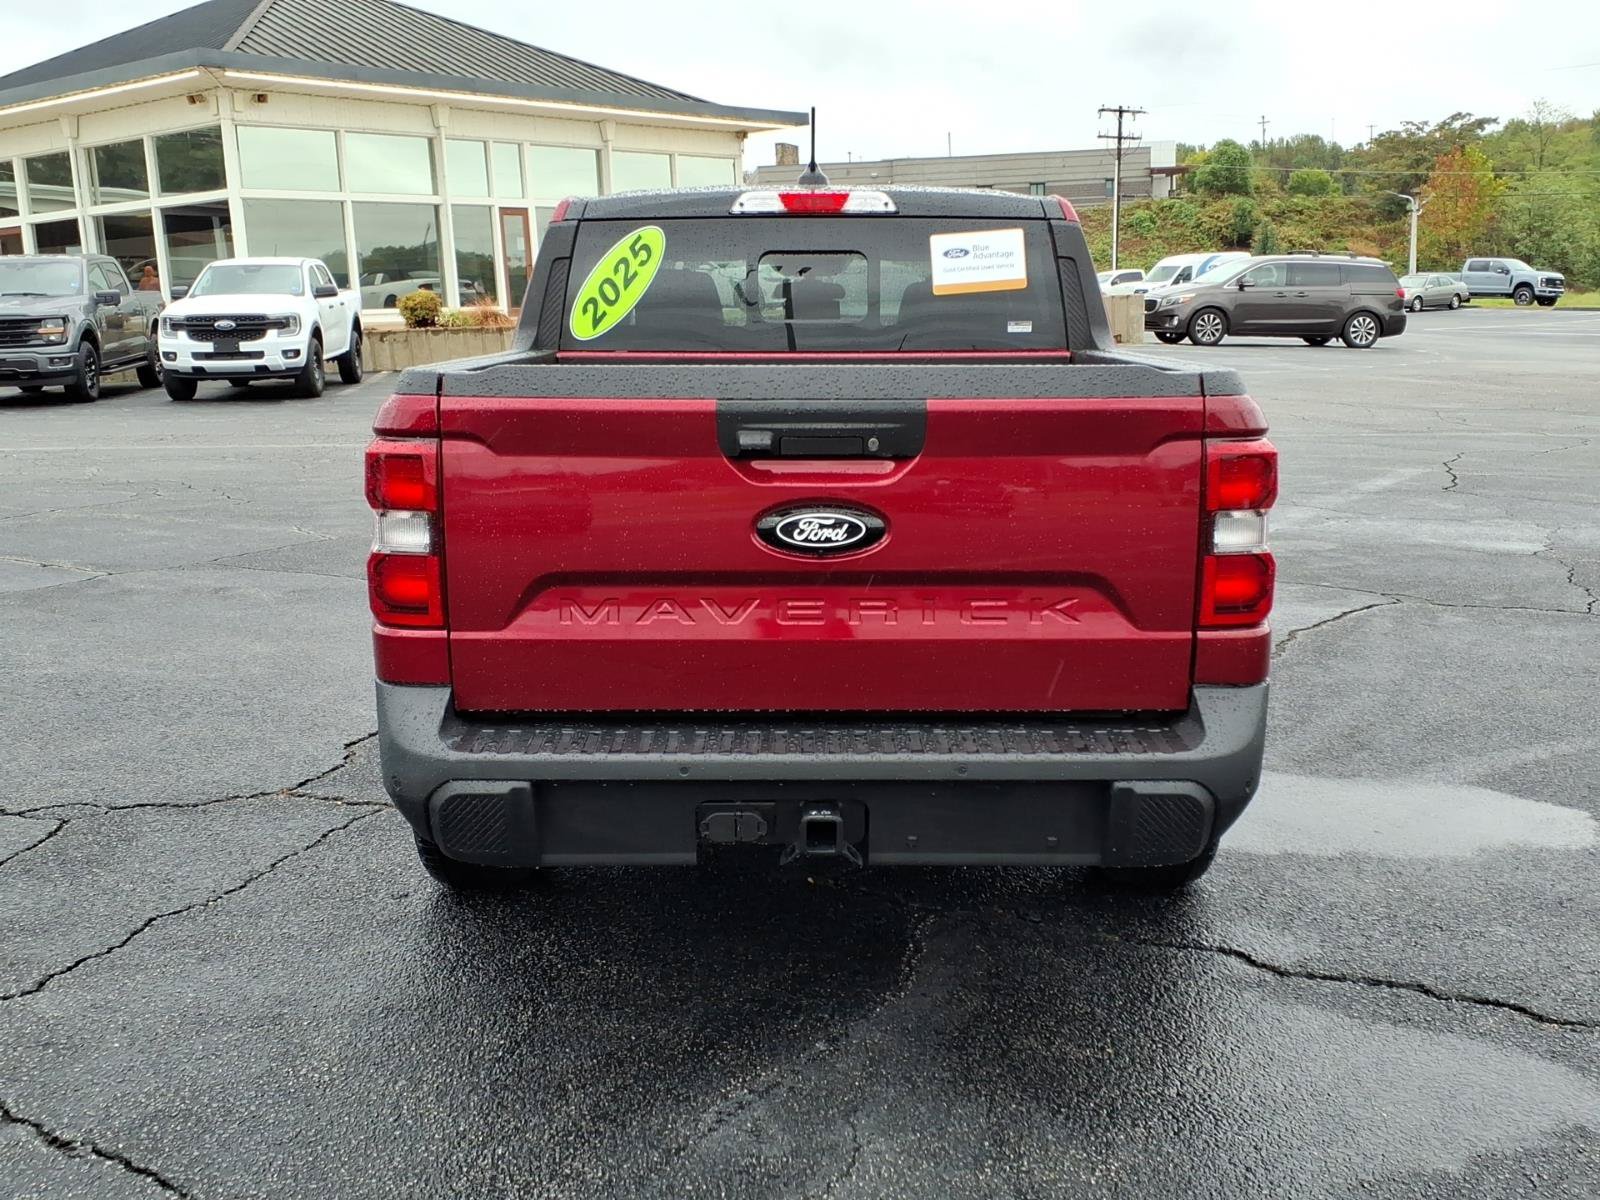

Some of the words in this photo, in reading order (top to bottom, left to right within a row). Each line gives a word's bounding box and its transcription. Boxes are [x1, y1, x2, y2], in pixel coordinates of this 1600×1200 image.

[972, 244, 990, 252] Blue
[973, 251, 1014, 260] Advantage
[582, 234, 652, 331] 2025
[793, 518, 849, 541] Ford
[559, 597, 1081, 626] MAVERICK
